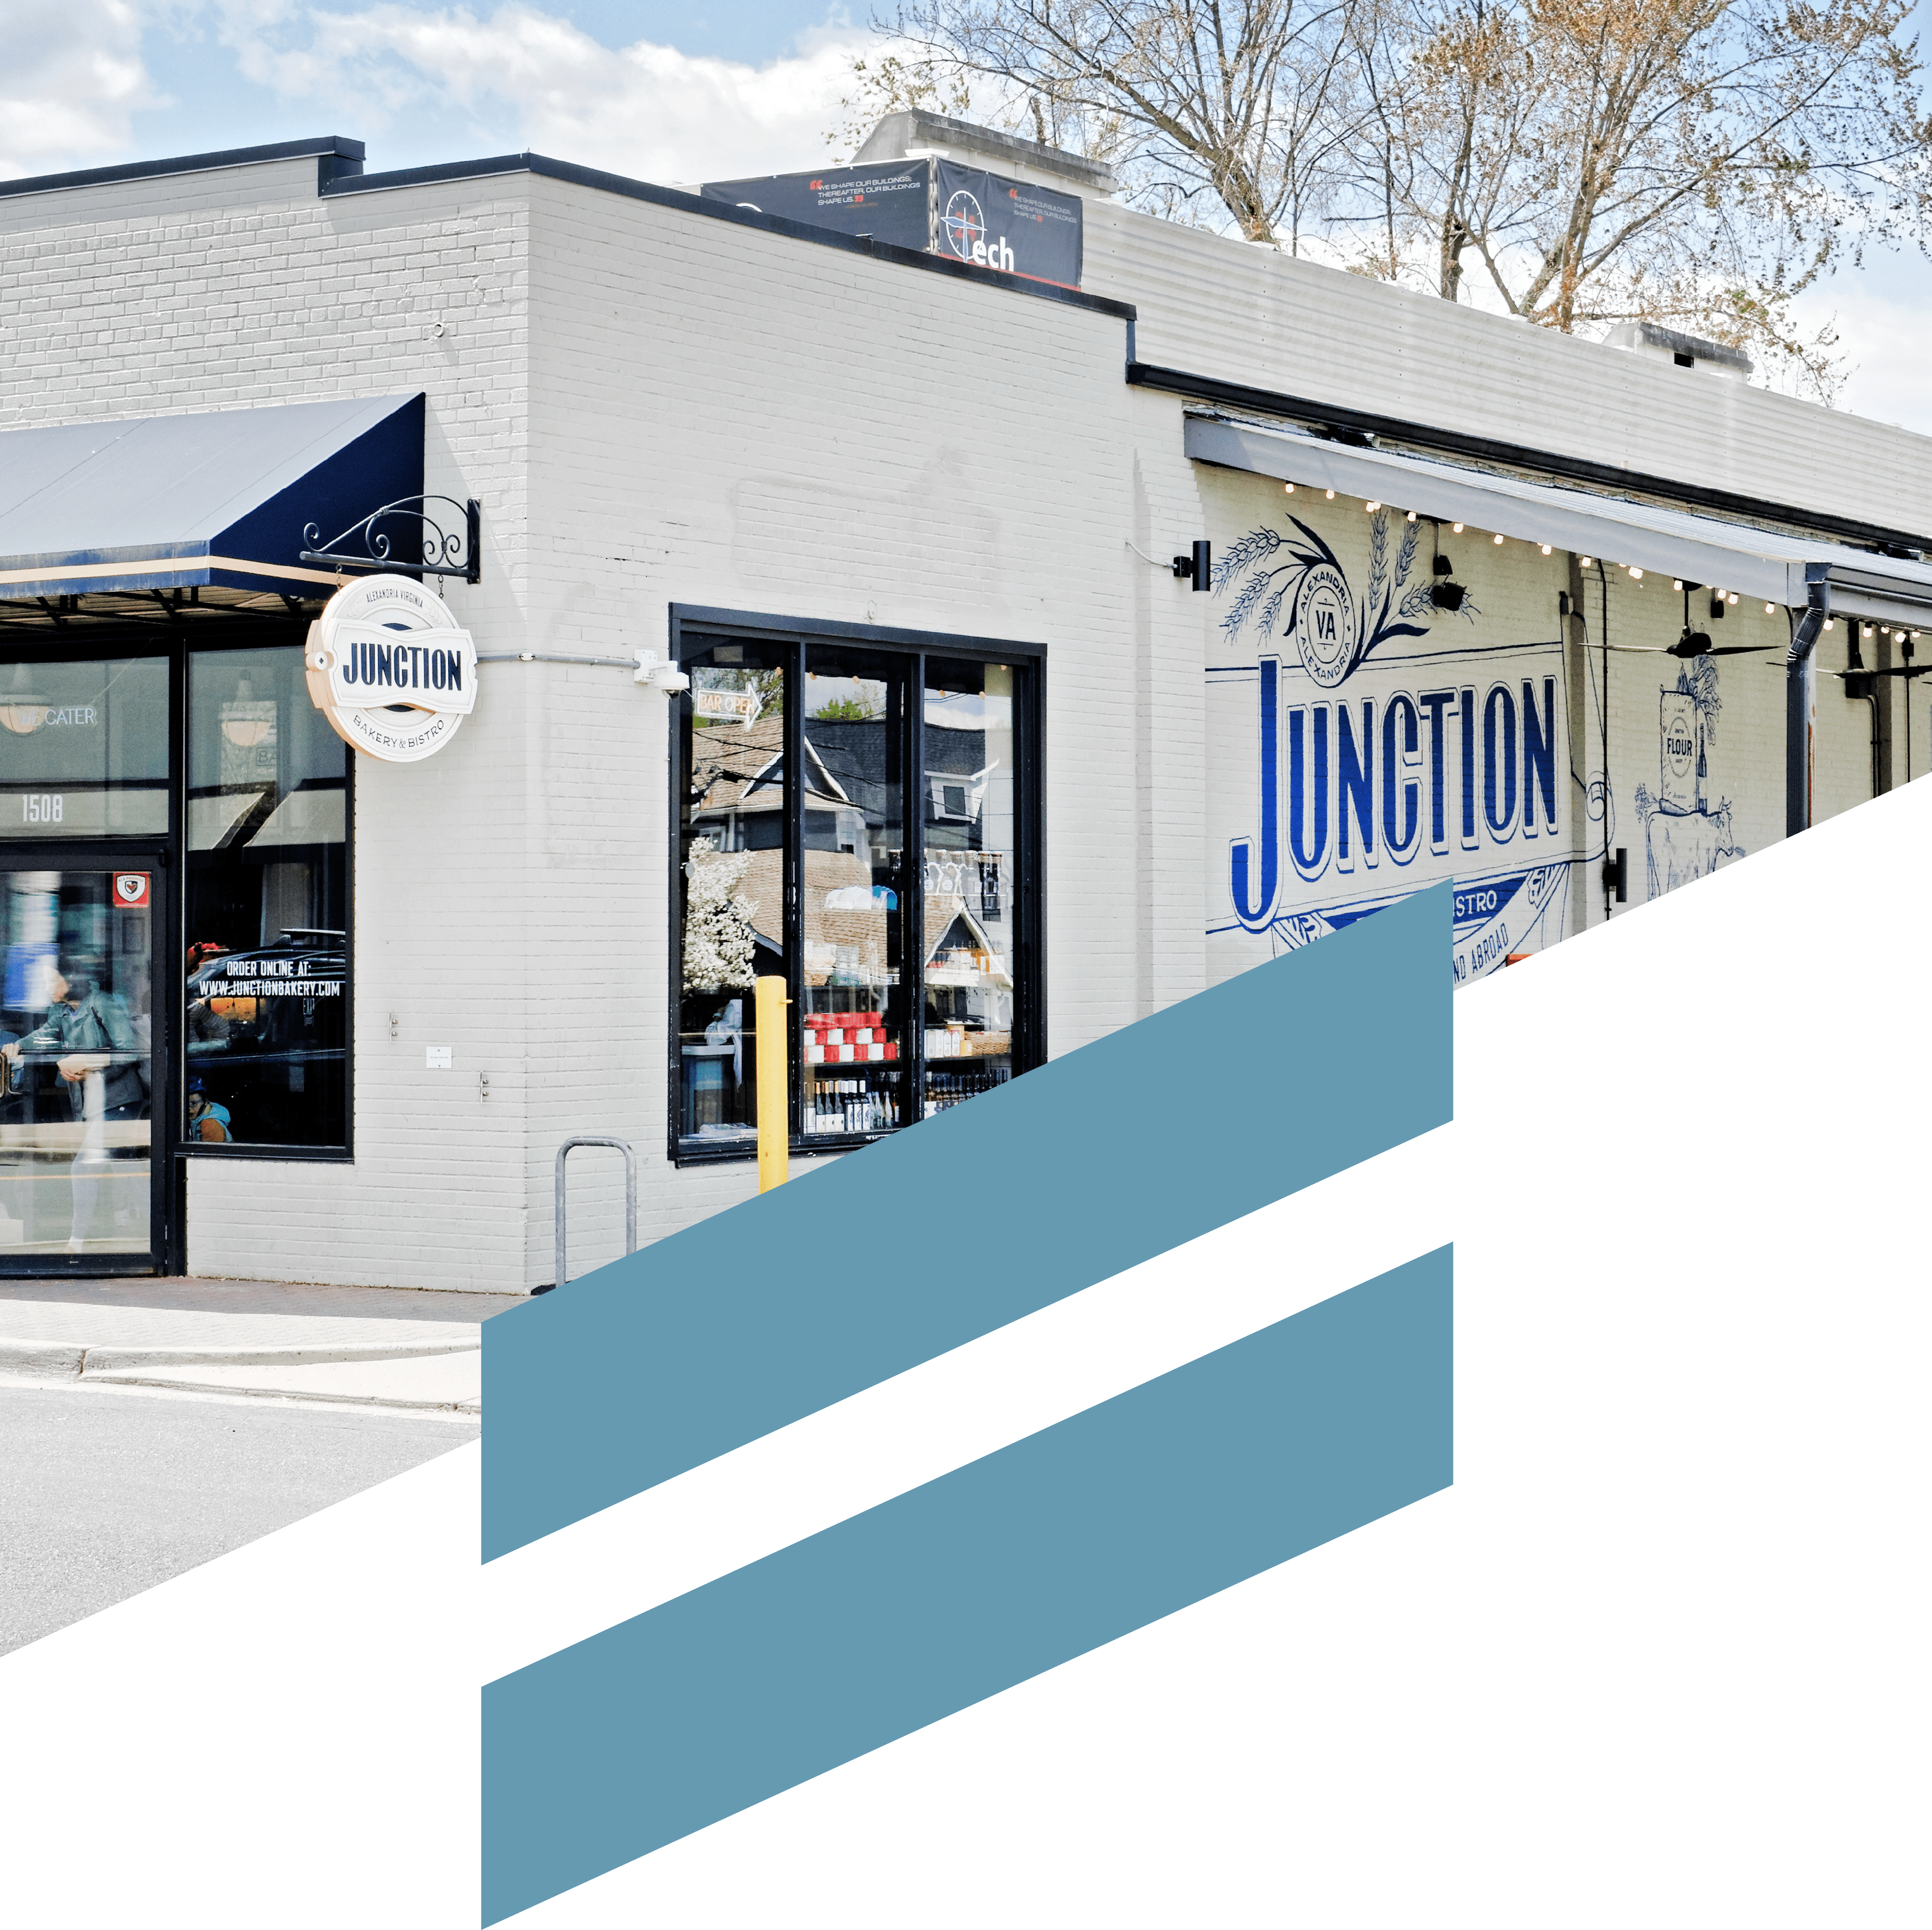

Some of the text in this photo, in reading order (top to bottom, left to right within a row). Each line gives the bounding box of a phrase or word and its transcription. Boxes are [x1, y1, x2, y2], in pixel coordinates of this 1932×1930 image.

[818, 187, 865, 198] THEREAFTER,
[882, 182, 921, 191] BUILDINGS
[1023, 197, 1038, 206] SHAPE
[1014, 210, 1029, 218] SHAPE
[366, 589, 423, 609] ALEXANDRIA VIRGINIA
[1300, 571, 1350, 617] ALEXANDRIA
[1316, 610, 1336, 640] VA
[343, 643, 462, 691] JUNCTION
[1300, 637, 1351, 680] ALEXANDRIA
[700, 694, 755, 714] BAR OPEN
[45, 708, 94, 725] CATER
[353, 715, 444, 748] BAKERY & BISTRO
[1667, 738, 1692, 756] FLOUR
[1229, 654, 1558, 933] JUNCTION
[23, 795, 63, 822] 1508
[1472, 922, 1508, 974] ABROAD
[227, 961, 312, 977] ORDER ONLINE AT:
[199, 980, 340, 996] WWW.JUNCTIONBAKERY.COM
